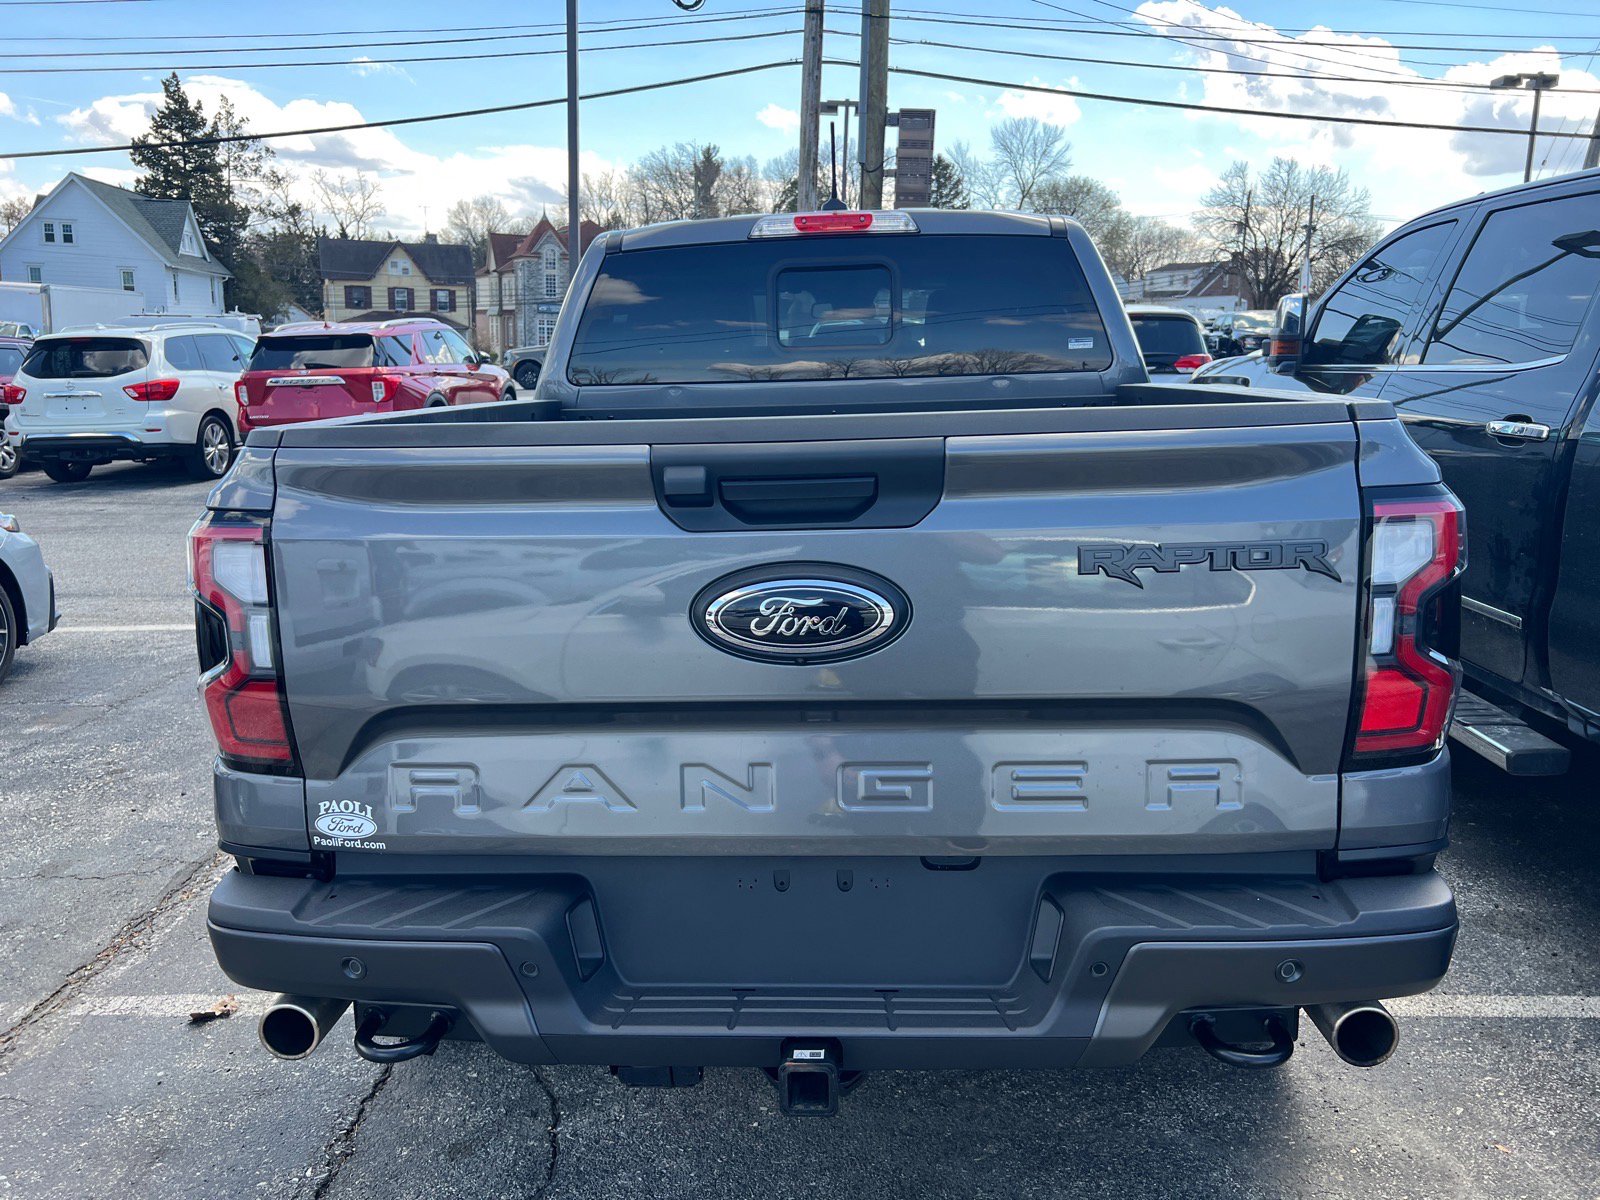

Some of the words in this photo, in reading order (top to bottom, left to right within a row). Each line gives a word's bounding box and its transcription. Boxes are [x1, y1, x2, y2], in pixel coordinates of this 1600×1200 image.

[1078, 538, 1342, 590] RAPTOR
[750, 596, 849, 636] Ford
[388, 762, 1242, 815] RANGER
[318, 799, 374, 820] PAOLI
[327, 816, 364, 834] Ford
[313, 836, 386, 850] PaoliFord.com
